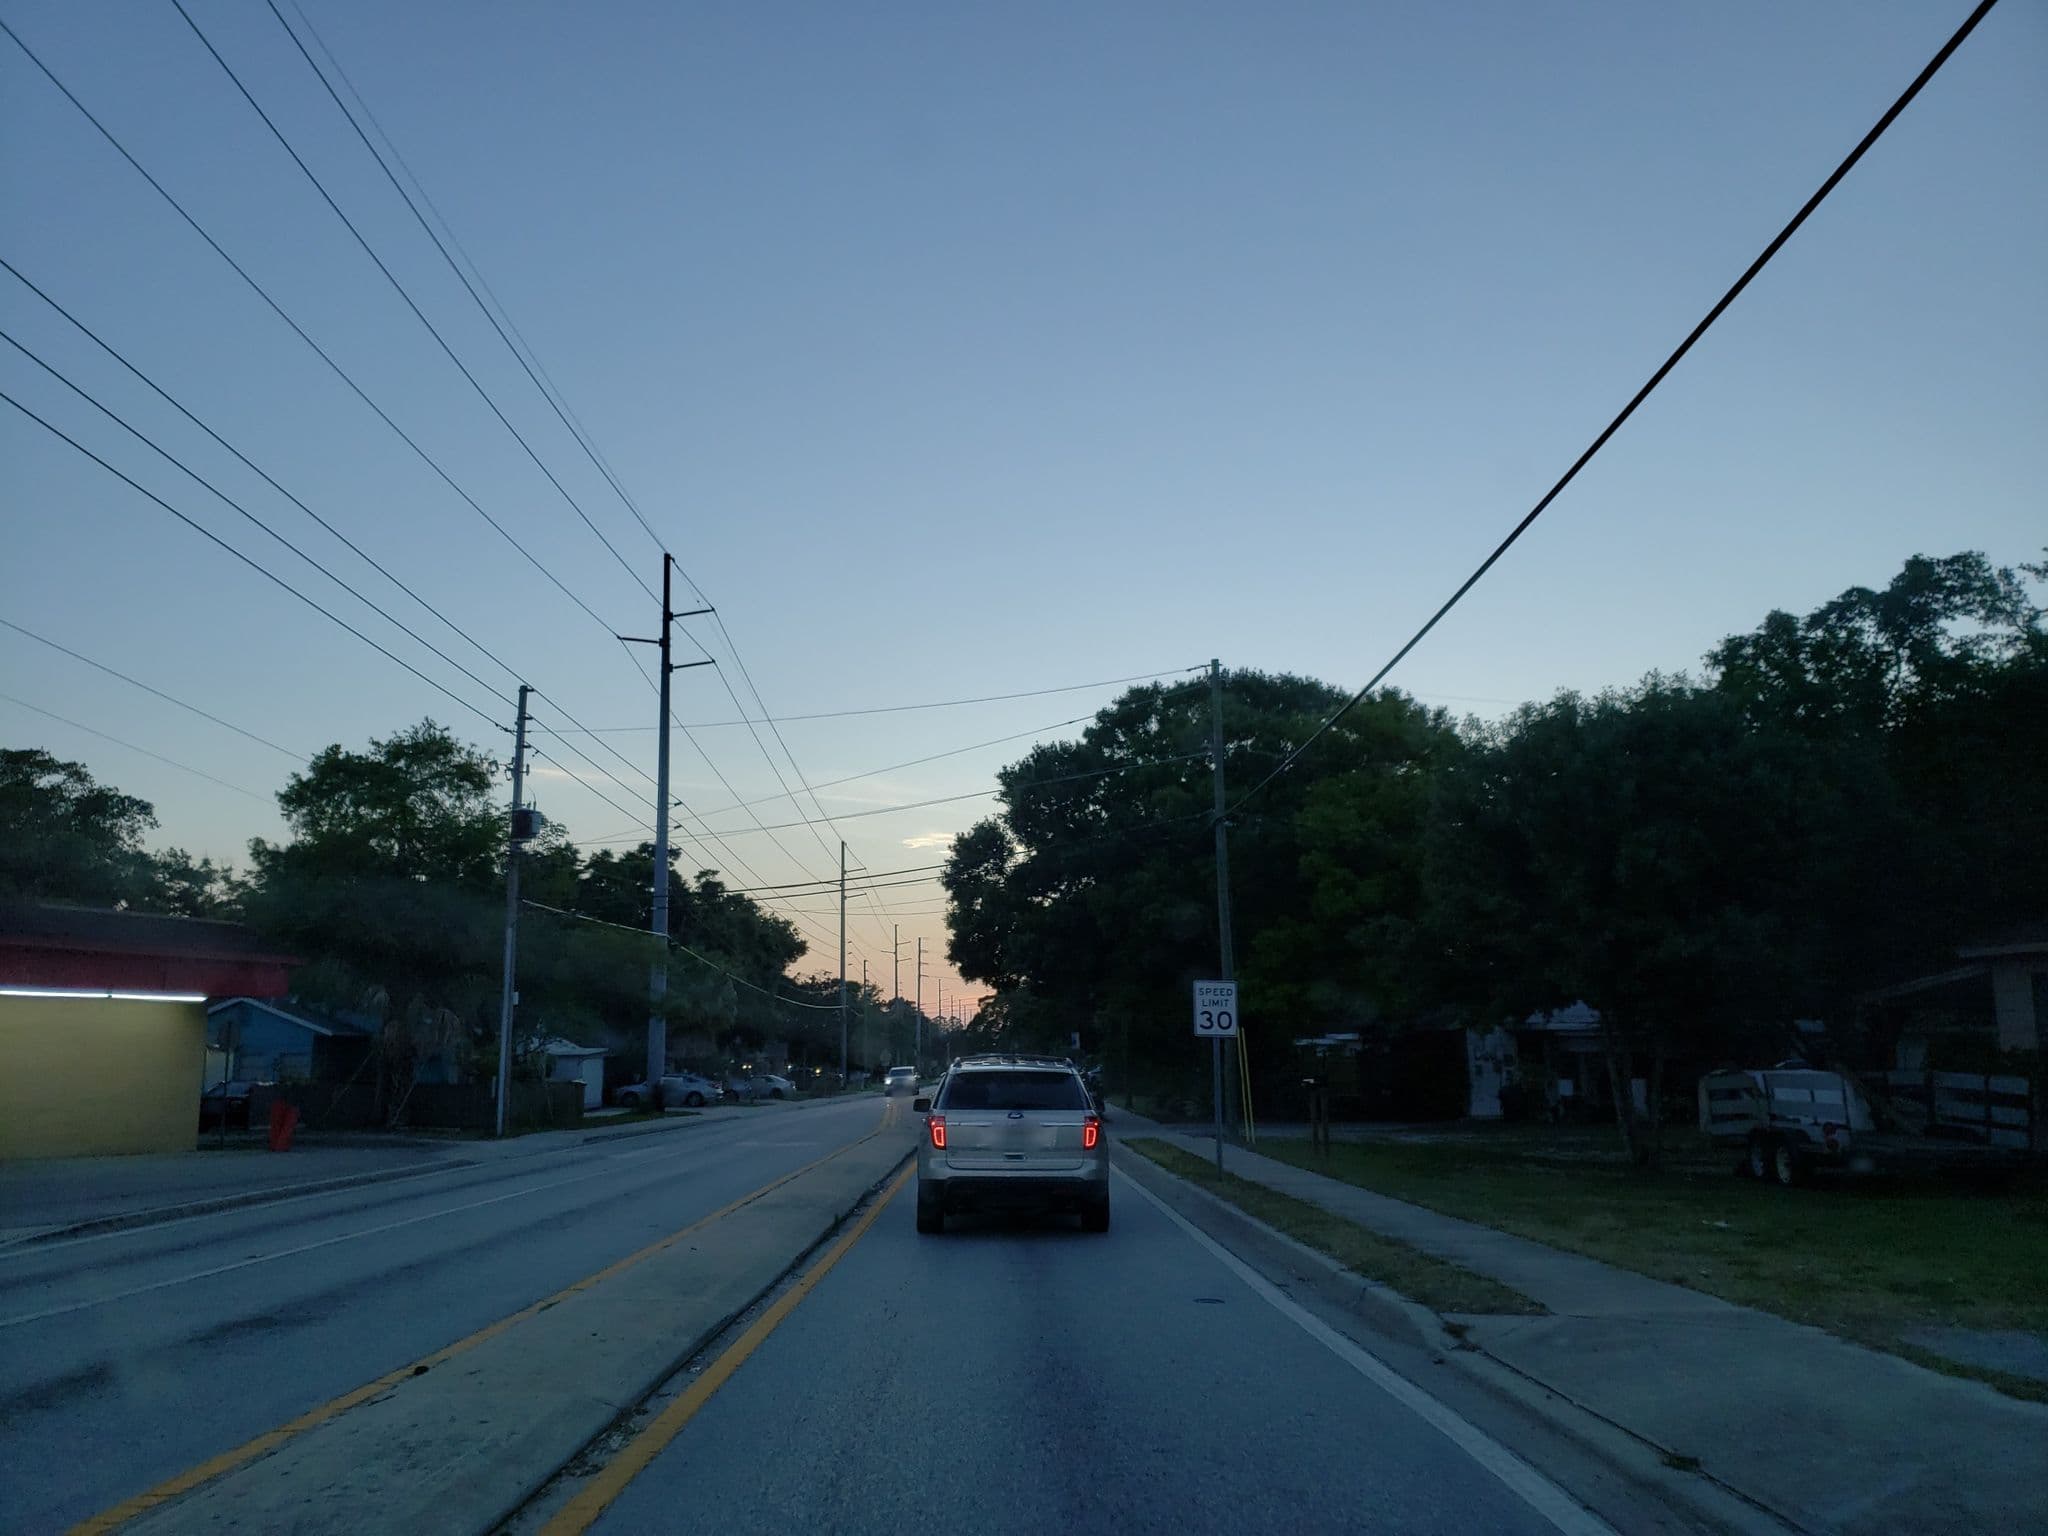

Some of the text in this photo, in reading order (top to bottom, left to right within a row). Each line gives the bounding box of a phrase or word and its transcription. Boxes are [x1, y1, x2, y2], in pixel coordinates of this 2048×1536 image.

[1199, 988, 1233, 996] SPEED
[1201, 999, 1229, 1007] LIMIT
[1200, 1011, 1232, 1030] 30
